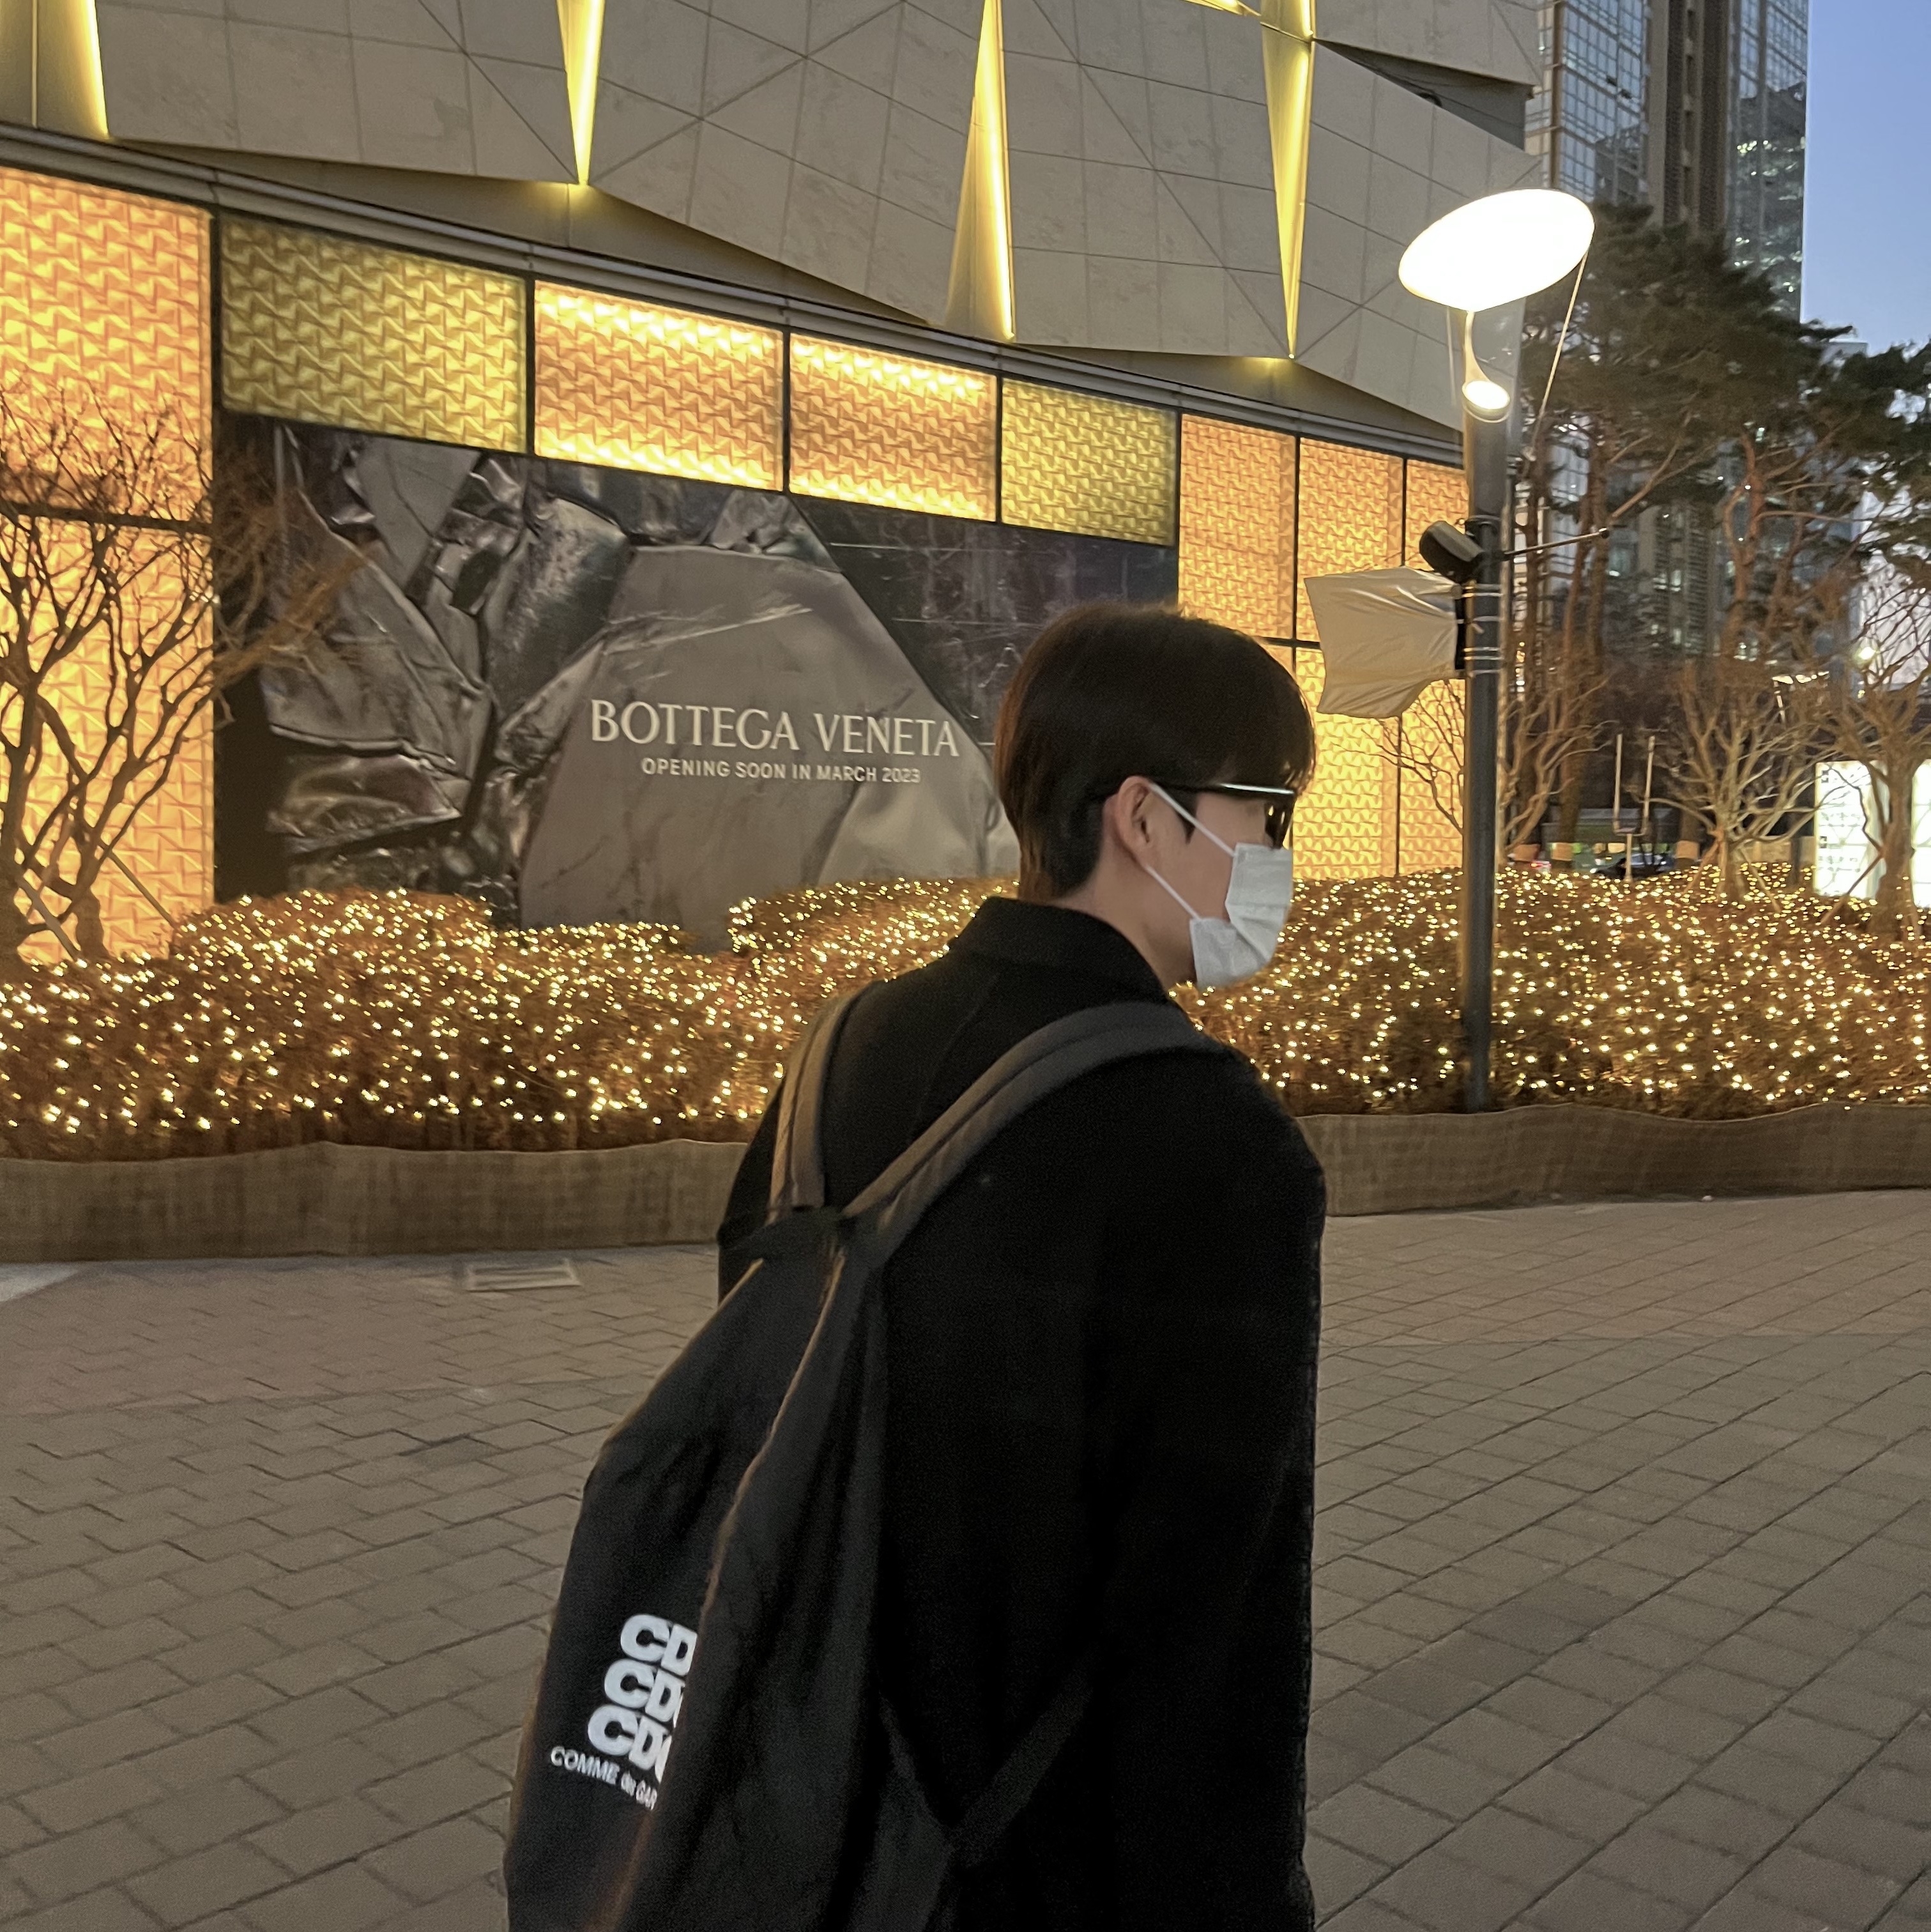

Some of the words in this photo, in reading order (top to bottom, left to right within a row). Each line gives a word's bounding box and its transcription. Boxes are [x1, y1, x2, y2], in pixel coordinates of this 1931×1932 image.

[592, 699, 799, 751] BOTTEGA
[814, 713, 959, 756] VENETA
[641, 757, 731, 778] OPENING
[735, 761, 786, 779] SOON
[792, 763, 811, 780] IN
[816, 765, 878, 783] MARCH
[882, 767, 921, 783] 2023
[604, 1658, 686, 1728] CD
[551, 1745, 620, 1785] COMME
